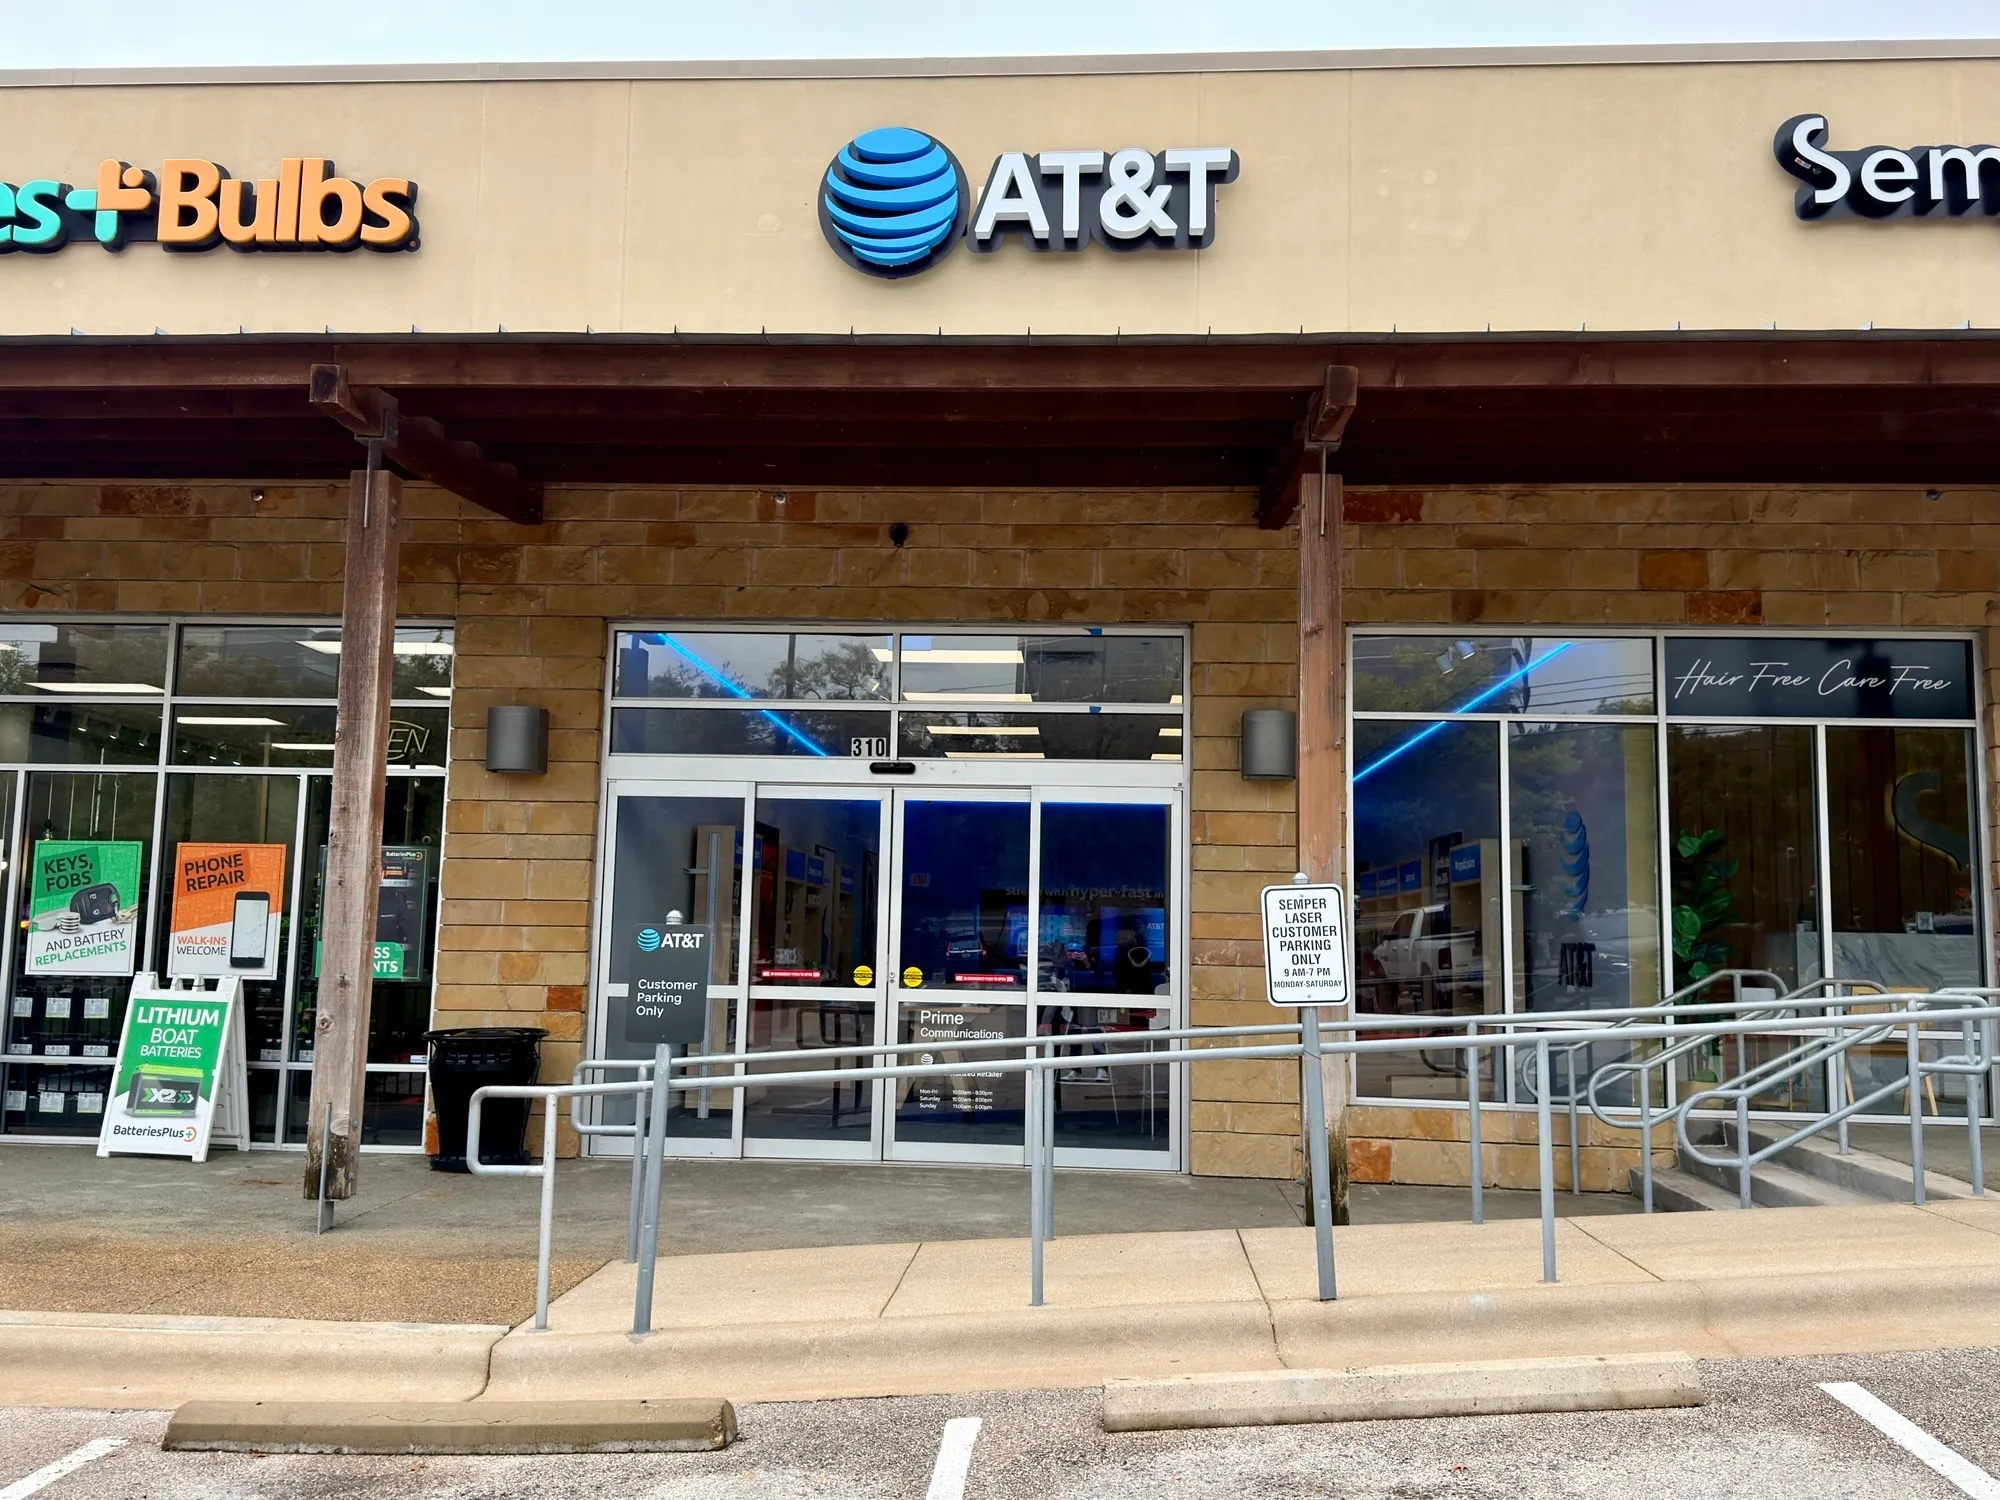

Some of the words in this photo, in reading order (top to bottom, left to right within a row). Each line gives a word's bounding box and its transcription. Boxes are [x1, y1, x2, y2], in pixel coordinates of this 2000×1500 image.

[975, 148, 1231, 240] AT&T
[1674, 659, 1744, 699] Hair
[1748, 662, 1811, 692] Free
[1817, 659, 1886, 696] Care
[1889, 665, 1952, 695] Free
[387, 728, 430, 753] EN
[853, 738, 885, 757] 310
[44, 853, 93, 875] KEYS,
[184, 853, 244, 876] PHONE
[45, 870, 92, 892] FOBS
[186, 869, 245, 892] REPAIR
[1279, 898, 1327, 911] SEMPER
[1285, 912, 1323, 924] LASER
[1272, 925, 1337, 938] CUSTOMER
[45, 938, 72, 952] AND
[74, 928, 125, 946] BATTERY
[177, 935, 227, 945] WALK-INS
[660, 933, 704, 948] AT&T
[1280, 939, 1331, 951] PARKING
[35, 940, 127, 966] REPLACEMENTS
[176, 945, 226, 956] WELCOME
[373, 946, 391, 959] SS
[373, 960, 399, 973] NTS
[1291, 953, 1321, 966] ONLY
[1558, 942, 1596, 987] AT&T
[1284, 968, 1290, 977] 9
[1291, 968, 1314, 977] AM-7
[1317, 967, 1331, 976] PM
[637, 979, 698, 991] Customer
[1274, 979, 1343, 988] MONDAY-SATURDAY
[636, 992, 682, 1006] Parking
[137, 1006, 220, 1027] LITHIUM
[636, 1005, 664, 1018] Only
[920, 1010, 964, 1025] Prime
[150, 1027, 199, 1045] BOAT
[920, 1027, 1004, 1040] Communications
[140, 1044, 202, 1059] BATTERIES
[113, 1124, 184, 1138] BatteriesPlus
